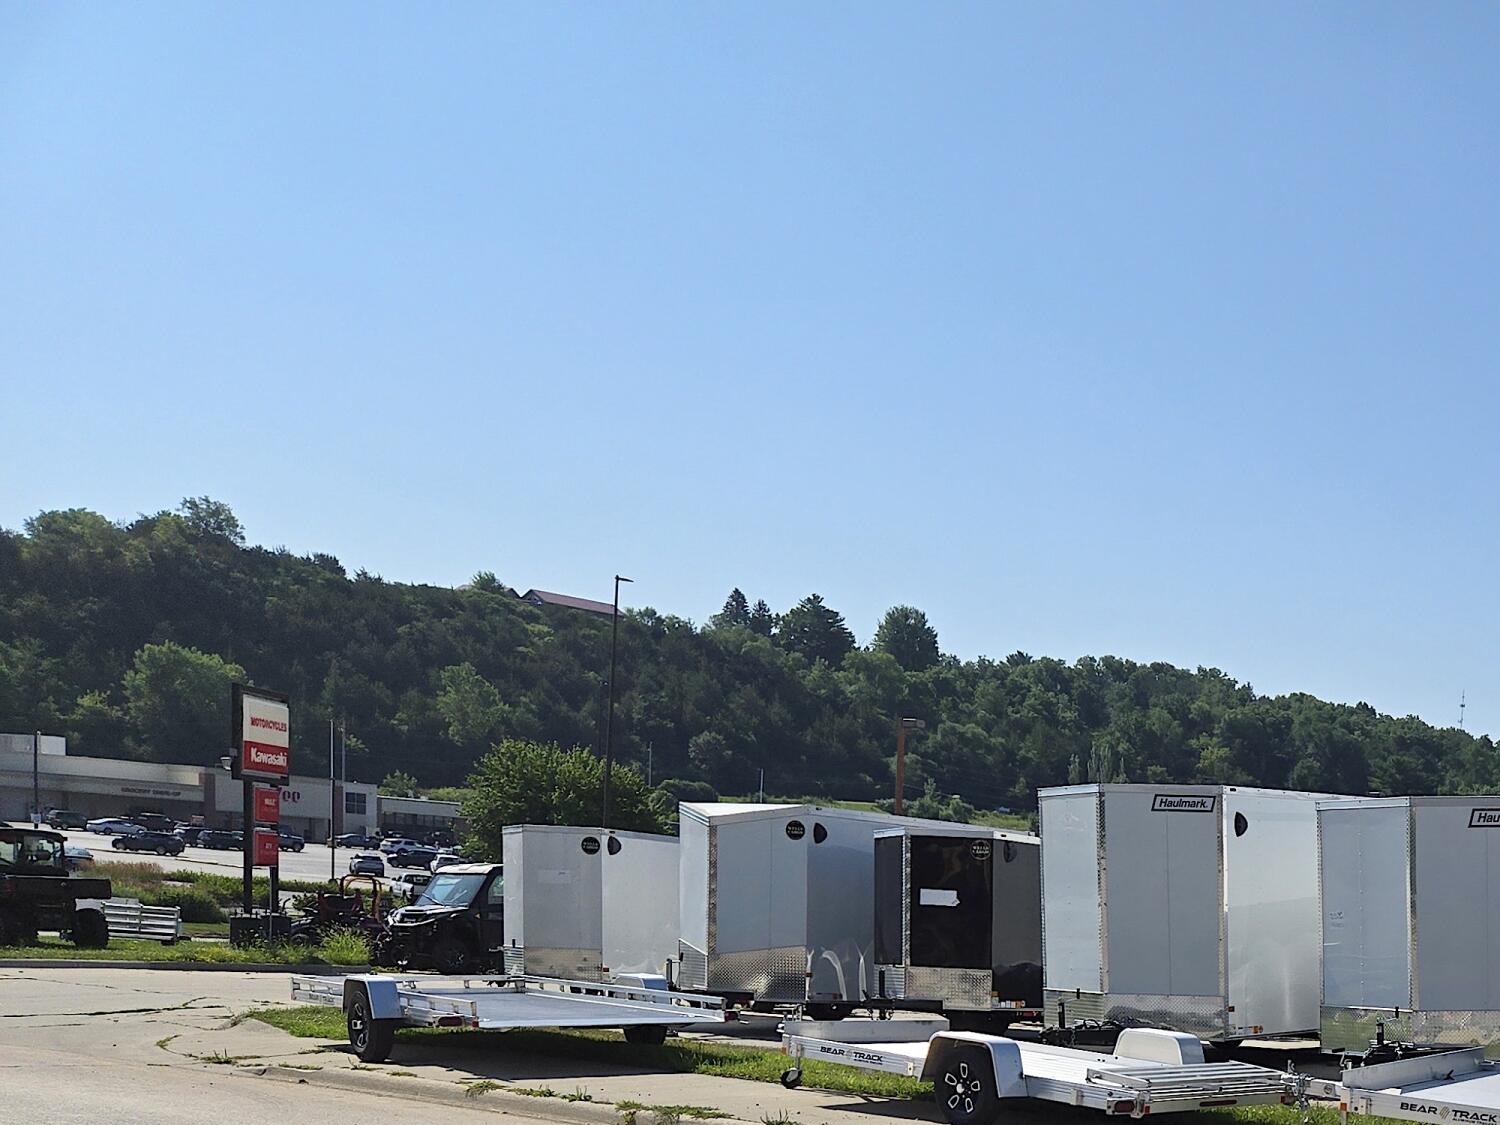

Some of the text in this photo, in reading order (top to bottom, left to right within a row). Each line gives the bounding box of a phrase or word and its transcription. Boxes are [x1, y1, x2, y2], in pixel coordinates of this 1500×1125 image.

[250, 717, 287, 732] MOTORCYCLES
[250, 747, 288, 767] Kawasaki
[820, 1046, 846, 1056] BEAR
[853, 1051, 883, 1062] TRACK
[1400, 1102, 1498, 1123] BEAR TRACK
